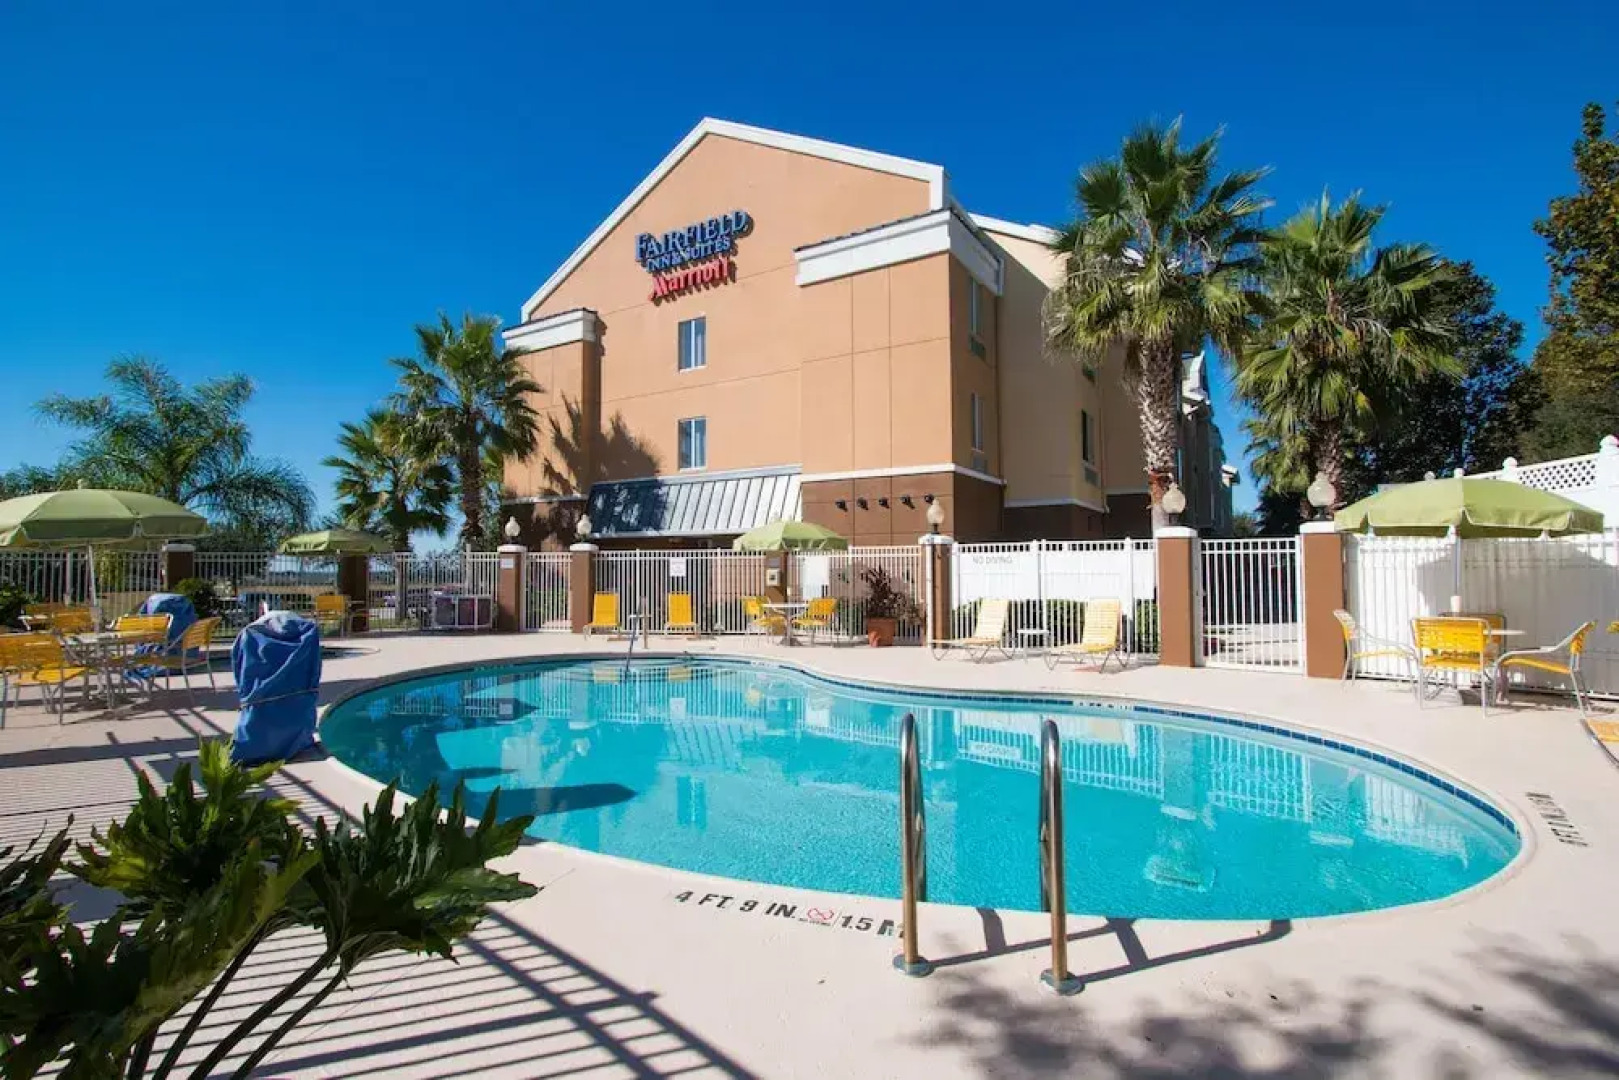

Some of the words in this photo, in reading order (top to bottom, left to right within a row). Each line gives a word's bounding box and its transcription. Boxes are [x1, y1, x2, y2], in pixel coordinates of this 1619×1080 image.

[635, 210, 751, 261] FAIRFIELD
[648, 256, 730, 302] Marriott
[674, 891, 694, 903] 4
[739, 899, 759, 912] 9
